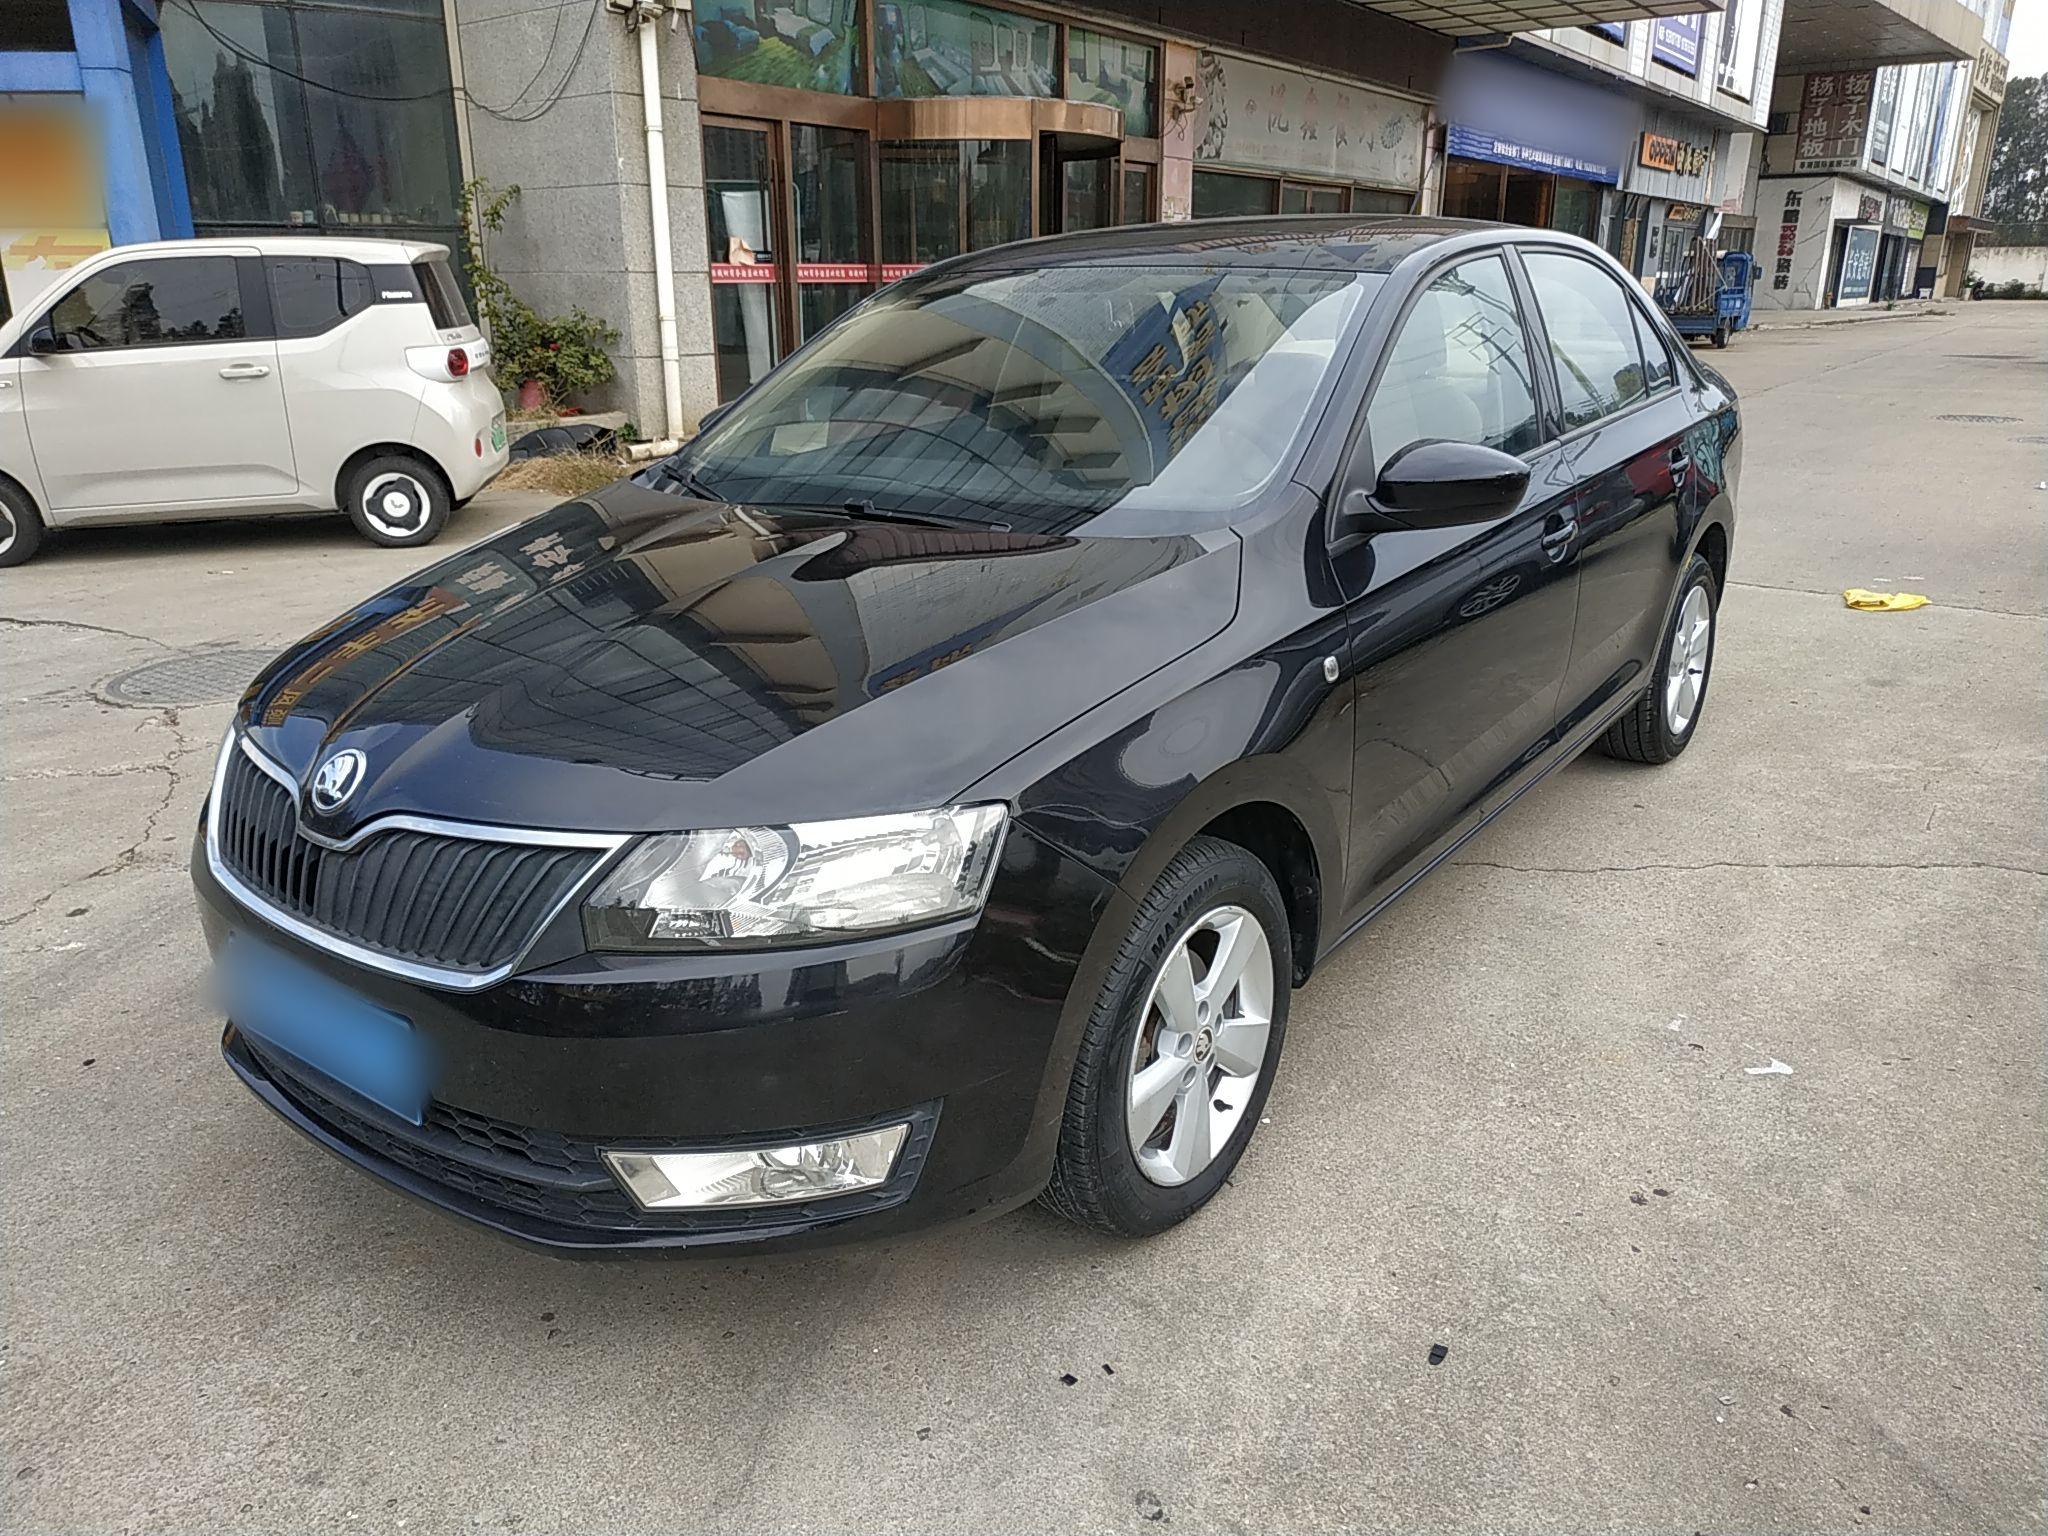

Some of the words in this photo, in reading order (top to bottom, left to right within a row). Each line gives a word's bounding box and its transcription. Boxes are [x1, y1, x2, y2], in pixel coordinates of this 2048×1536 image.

[1801, 76, 1834, 157] 扬子地板
[1839, 74, 1871, 155] 扬子木门
